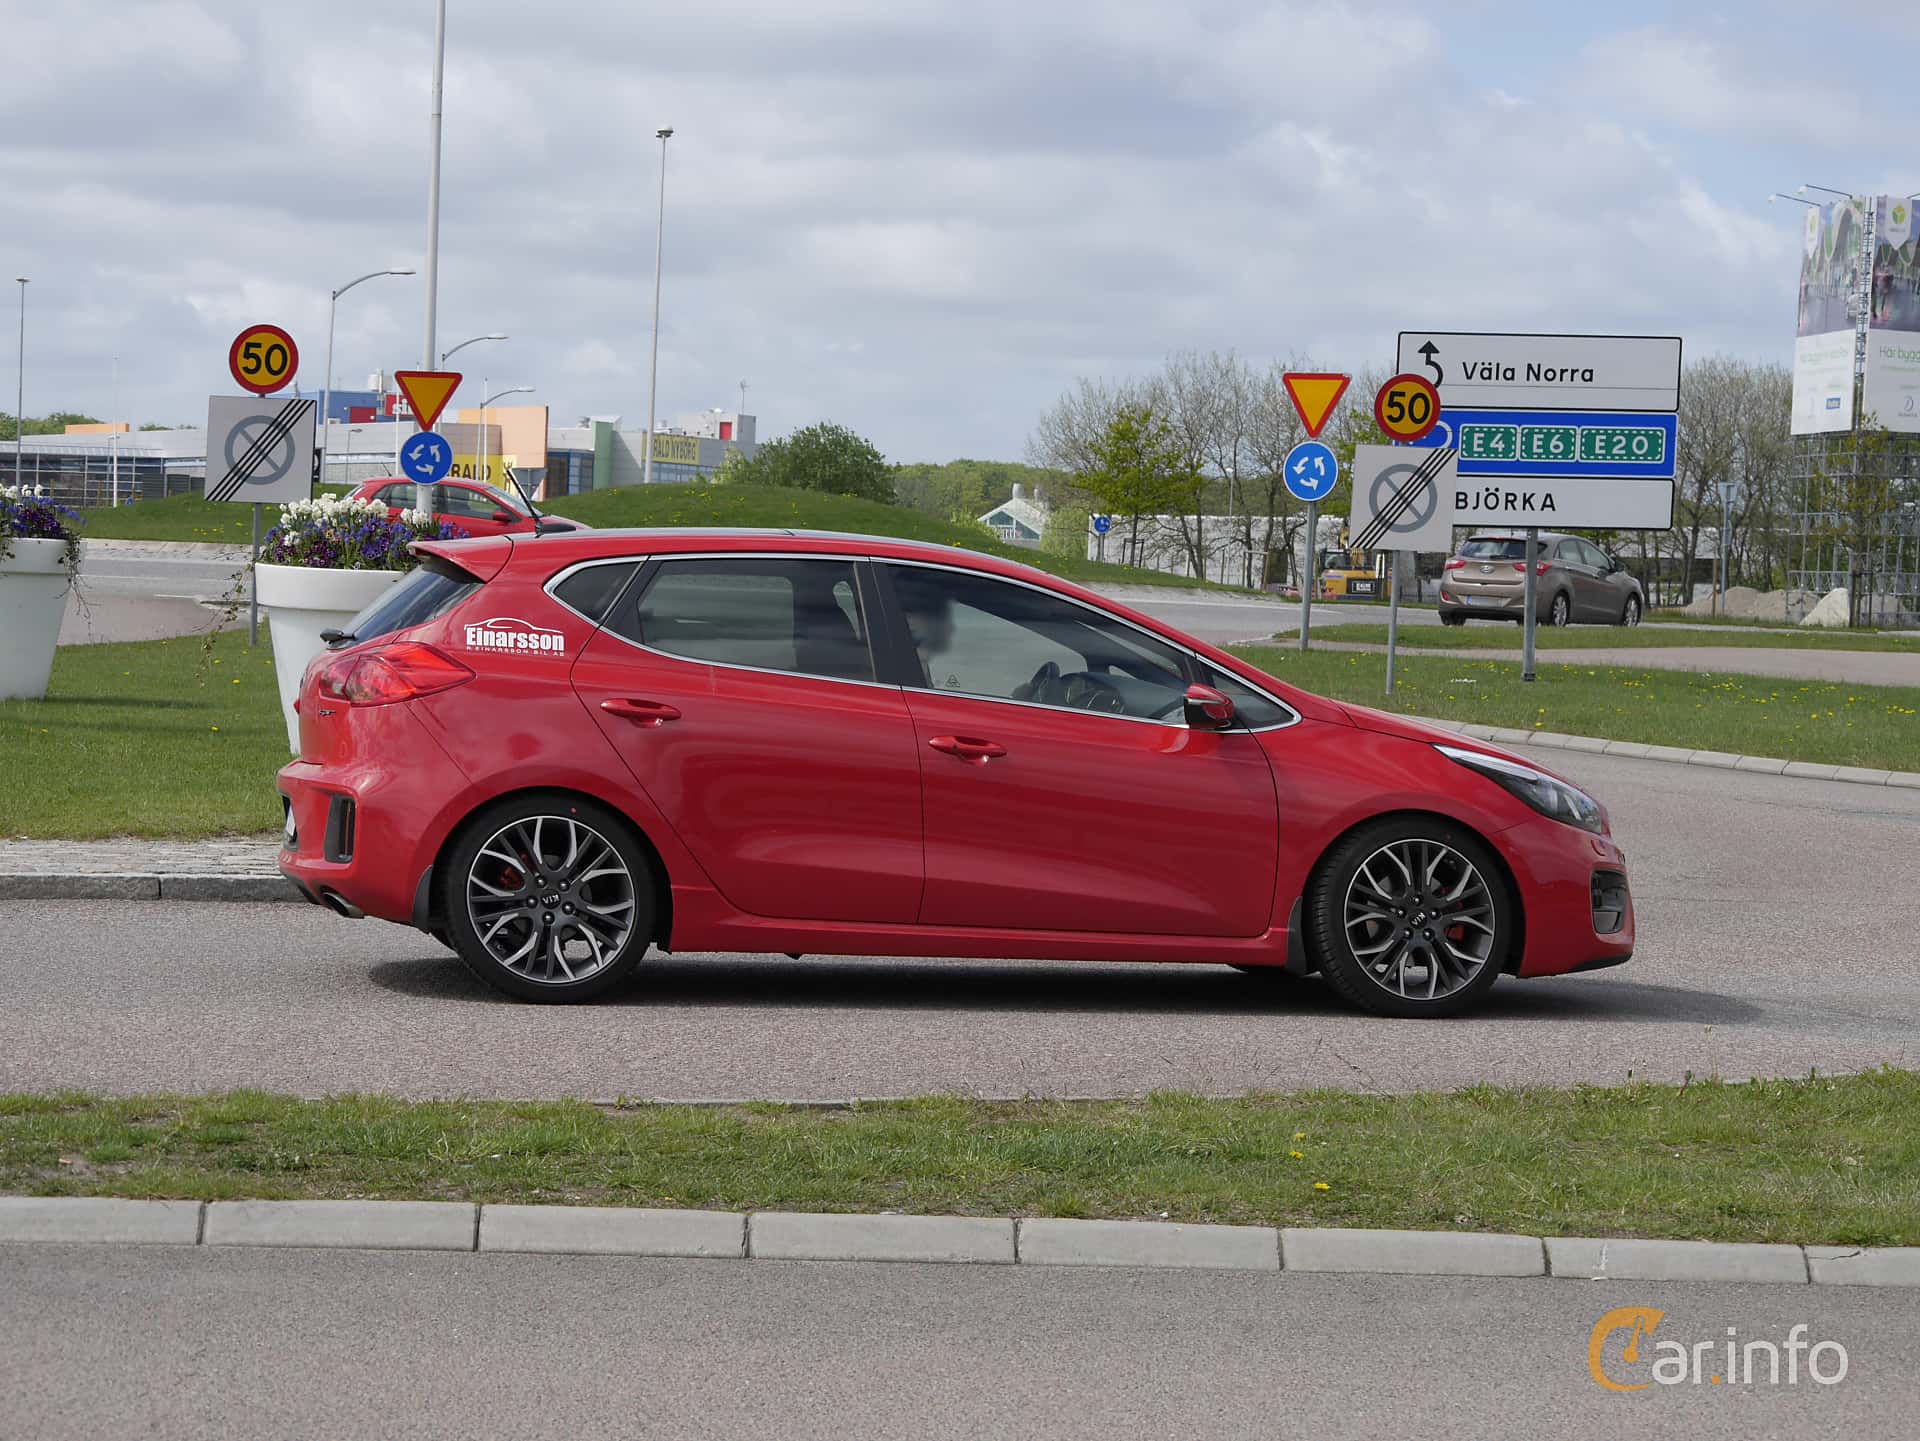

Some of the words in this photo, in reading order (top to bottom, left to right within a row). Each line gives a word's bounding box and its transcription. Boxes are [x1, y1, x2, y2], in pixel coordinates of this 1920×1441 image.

[242, 342, 288, 376] 50
[1462, 361, 1516, 381] Väla
[1526, 363, 1594, 382] Norra
[1387, 391, 1430, 424] 50
[1472, 432, 1505, 452] E4
[1532, 434, 1564, 453] E6
[1594, 435, 1649, 455] E20
[447, 463, 492, 480] RALD
[1456, 487, 1556, 511] BJÖRKA
[466, 627, 564, 651] Einarsson
